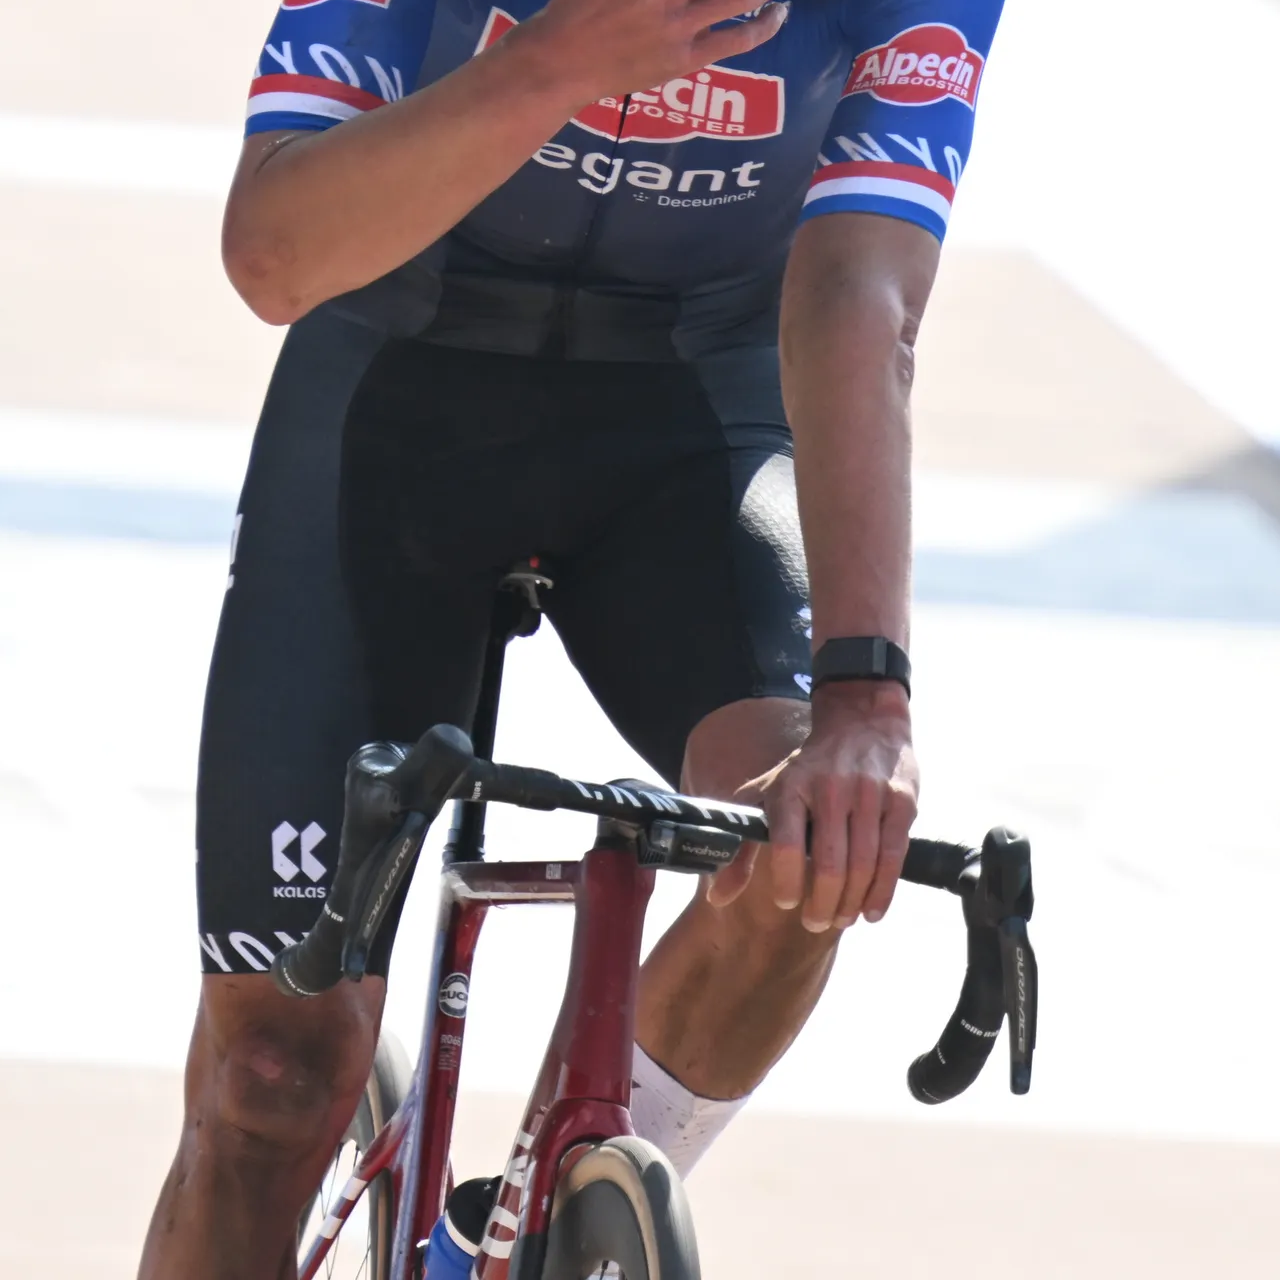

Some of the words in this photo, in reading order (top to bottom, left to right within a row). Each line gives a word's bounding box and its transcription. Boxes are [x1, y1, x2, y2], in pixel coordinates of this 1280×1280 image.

[856, 47, 975, 90] Alpecin
[851, 77, 888, 92] HAIR
[896, 76, 969, 99] BOOSTER
[657, 190, 757, 208] Deceuninck
[681, 843, 730, 859] wahoo
[1015, 946, 1027, 1054] DURA-ACE
